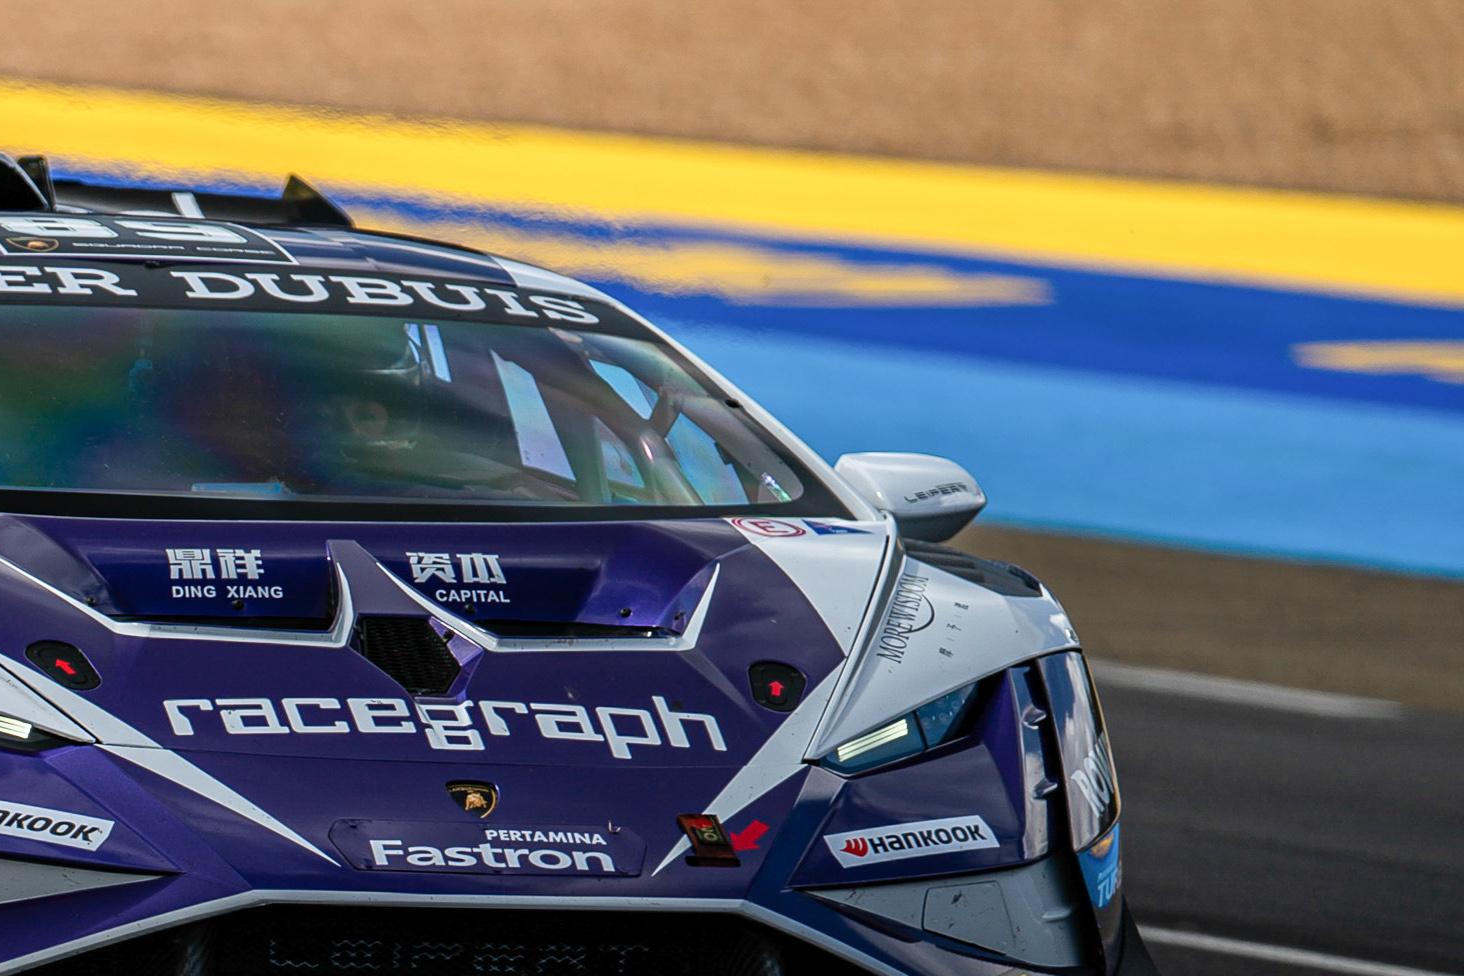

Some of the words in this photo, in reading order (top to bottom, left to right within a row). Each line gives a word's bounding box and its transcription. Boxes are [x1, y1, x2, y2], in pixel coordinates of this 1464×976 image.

[168, 267, 601, 327] DUBUIS
[165, 547, 265, 581] 鼎祥
[405, 551, 508, 586] 资本
[172, 586, 217, 600] DING
[227, 587, 284, 600] XIANG
[435, 589, 511, 604] CAPITAL
[876, 573, 935, 665] MOREWISDOM
[162, 696, 727, 760] racegraph
[485, 829, 607, 846] PERTAMINA
[369, 839, 616, 873] Fastron
